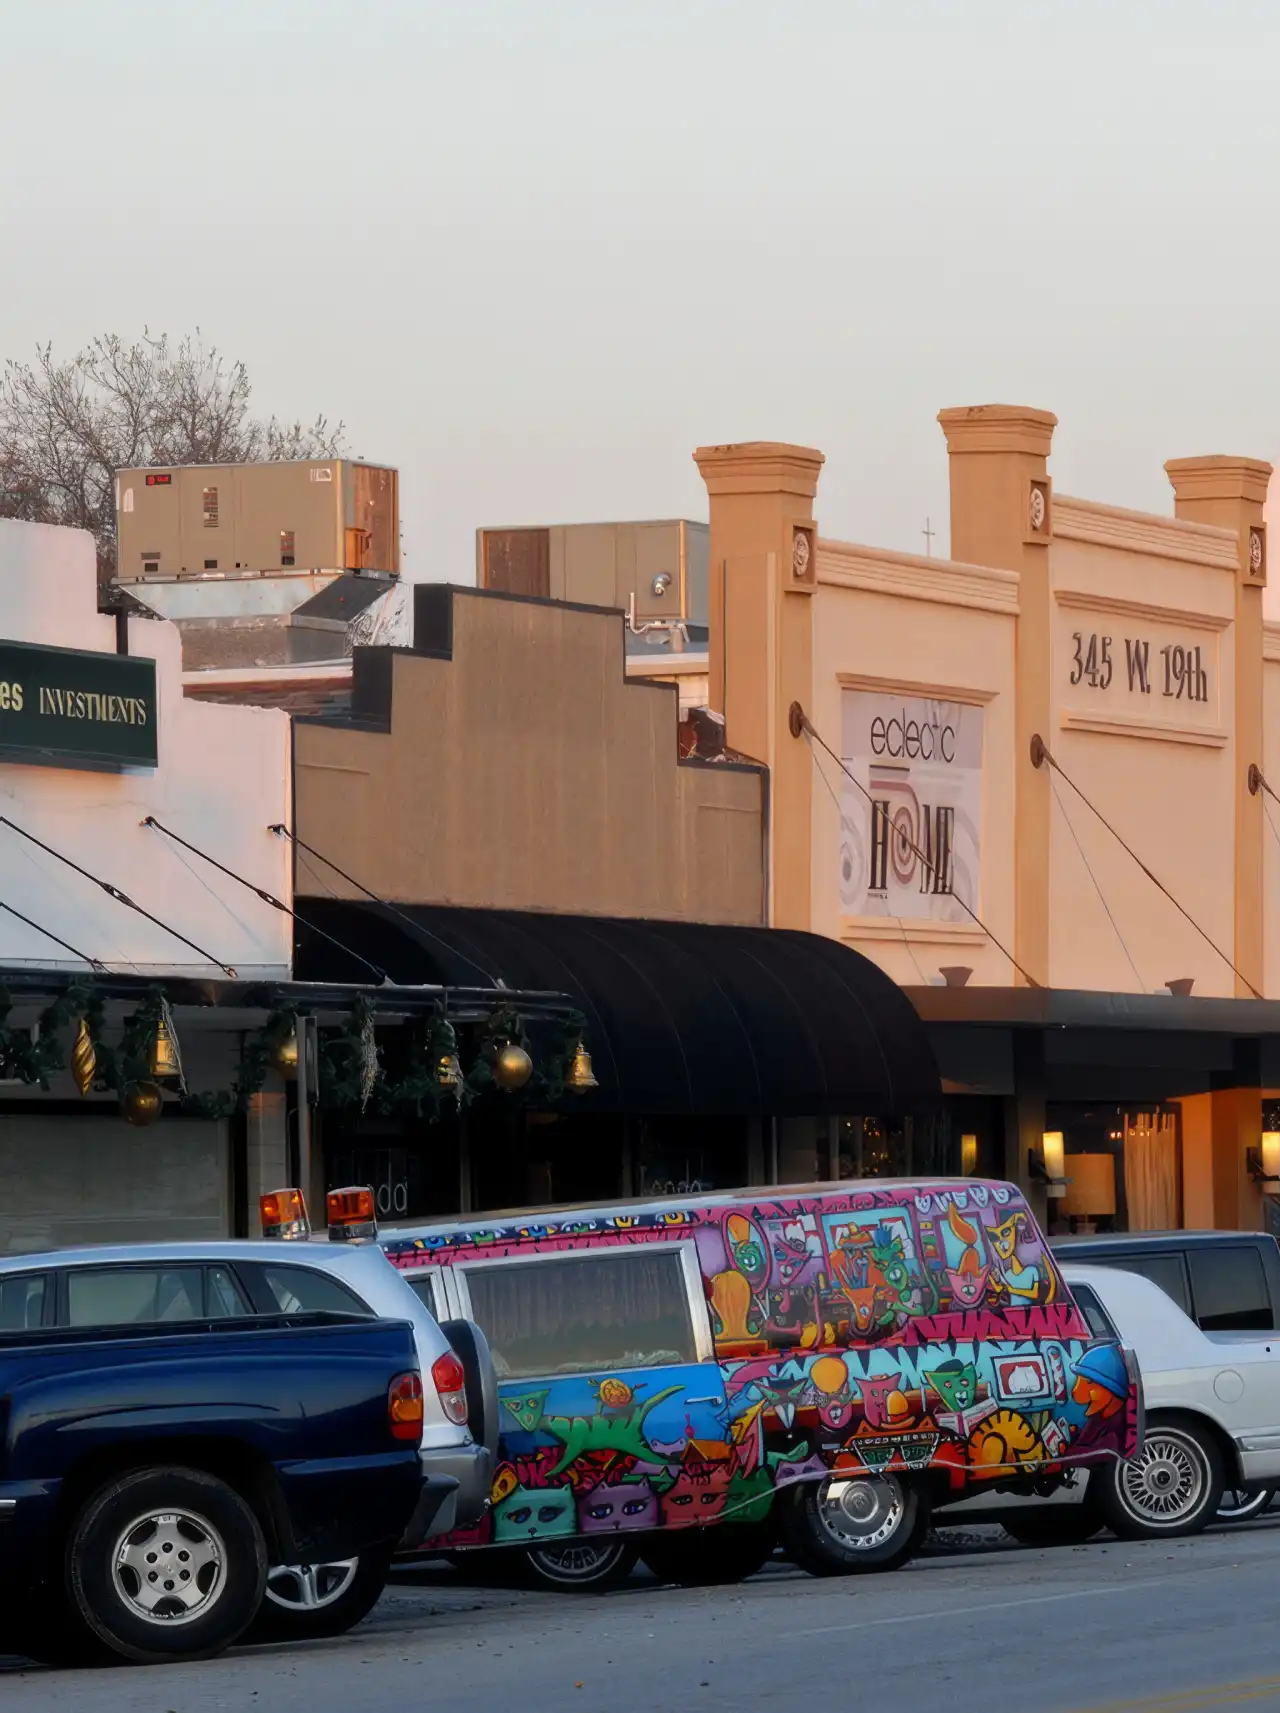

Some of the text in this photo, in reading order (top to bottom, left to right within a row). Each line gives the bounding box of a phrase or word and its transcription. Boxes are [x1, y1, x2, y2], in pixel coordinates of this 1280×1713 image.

[1070, 632, 1112, 690] 345
[1160, 645, 1208, 702] 19th
[39, 687, 147, 726] INVESTMENTS
